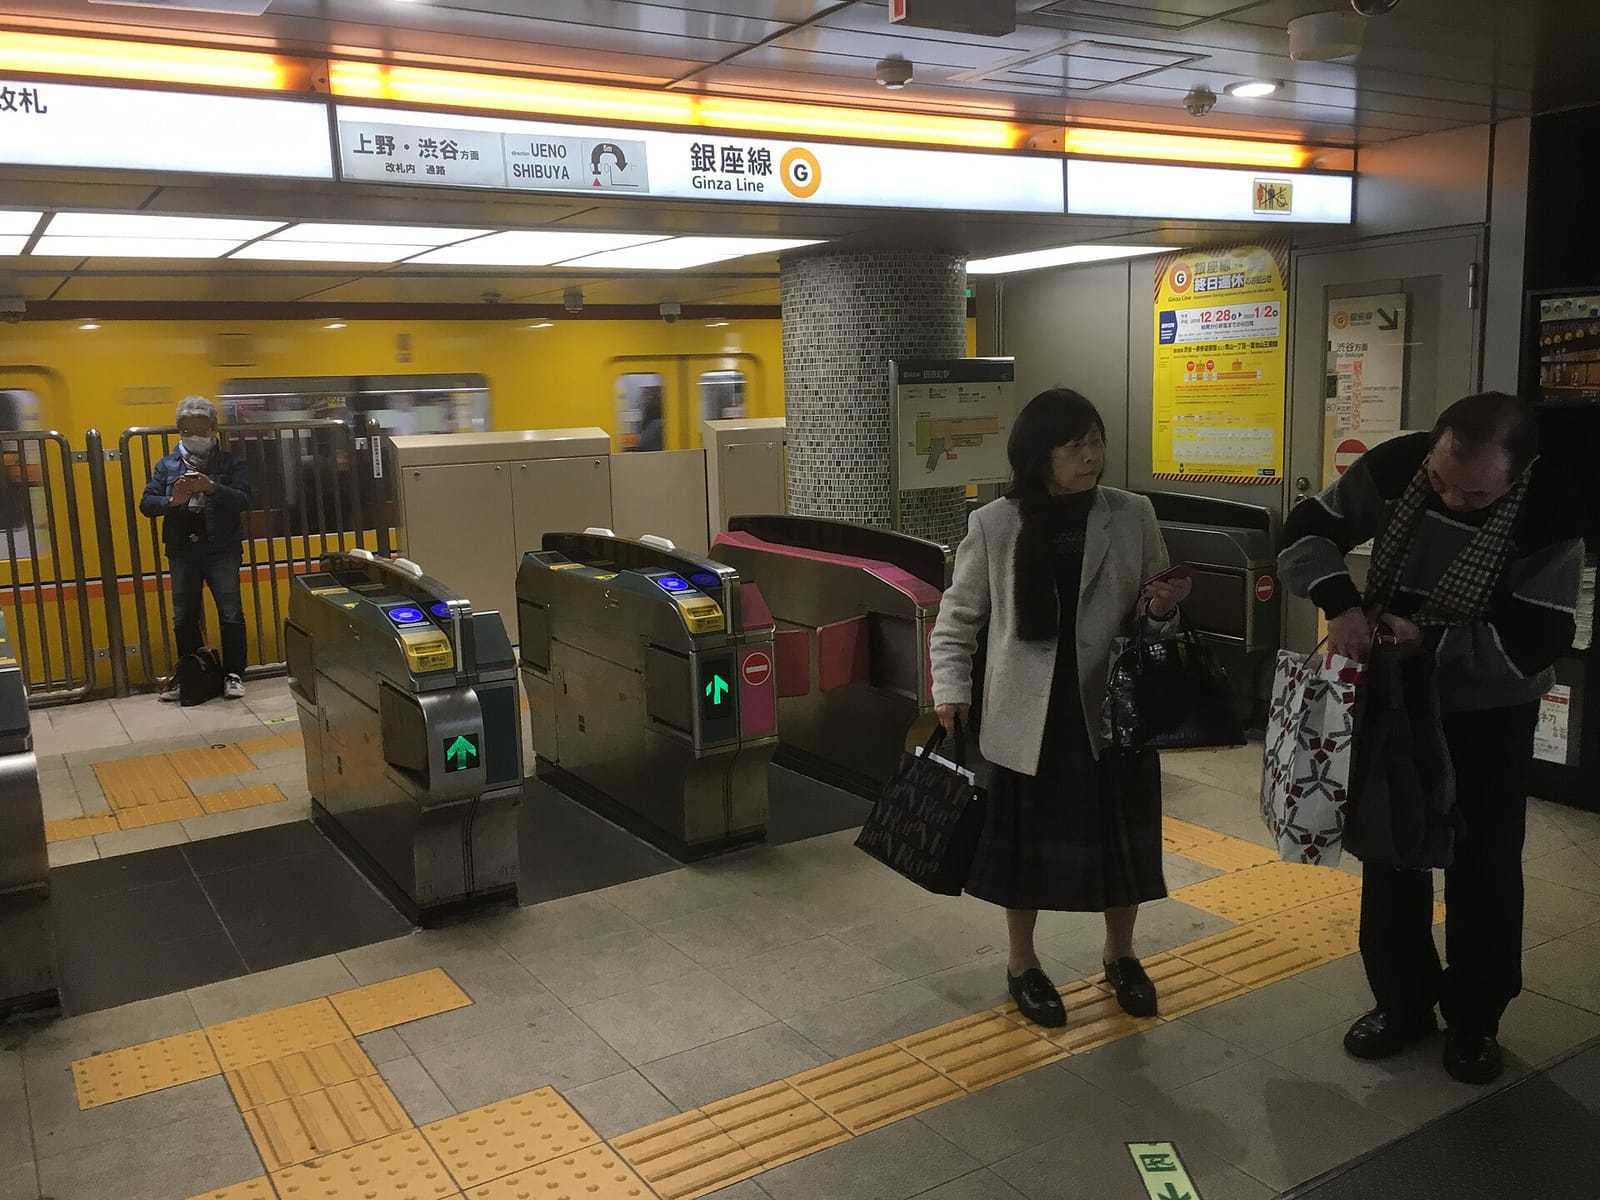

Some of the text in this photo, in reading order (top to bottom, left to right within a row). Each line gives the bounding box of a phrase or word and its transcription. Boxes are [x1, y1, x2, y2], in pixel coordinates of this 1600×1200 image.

[530, 142, 567, 159] UENO
[689, 142, 773, 177] 銀座線
[385, 162, 446, 176] 改札内 通路
[512, 163, 570, 180] SHIBUYA
[793, 164, 809, 182] G
[692, 175, 765, 193] Ginza Line
[1176, 272, 1185, 284] G
